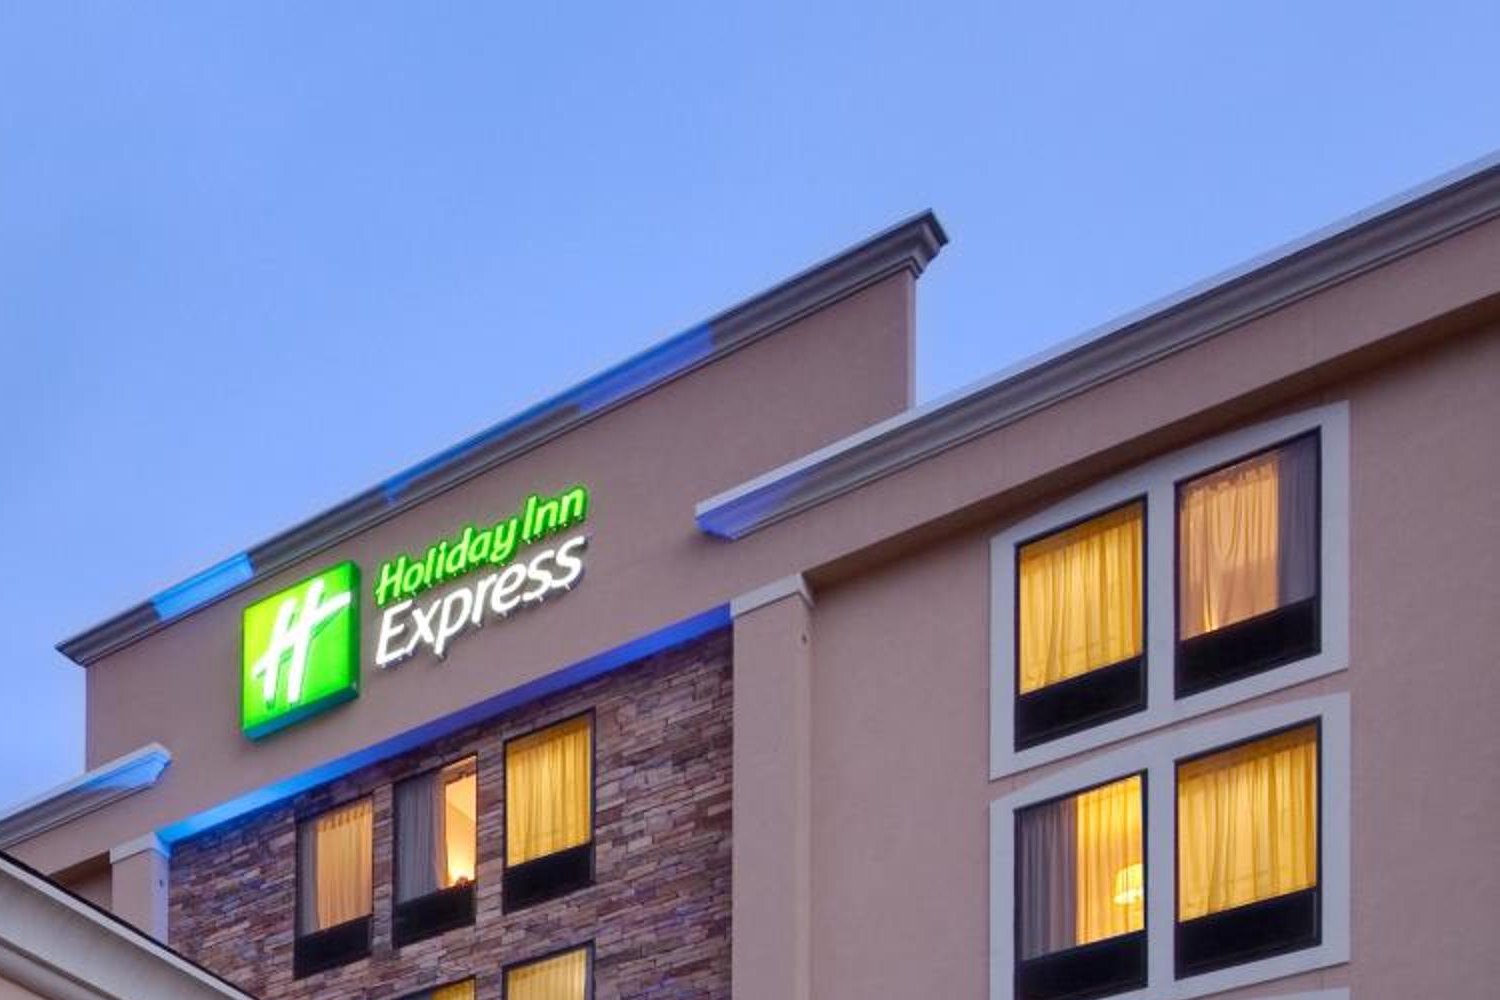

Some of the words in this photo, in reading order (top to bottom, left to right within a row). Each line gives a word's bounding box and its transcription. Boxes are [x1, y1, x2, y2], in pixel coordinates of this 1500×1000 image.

[375, 536, 586, 664] Express
[376, 517, 518, 604] Holiday
[522, 485, 587, 541] Inn
